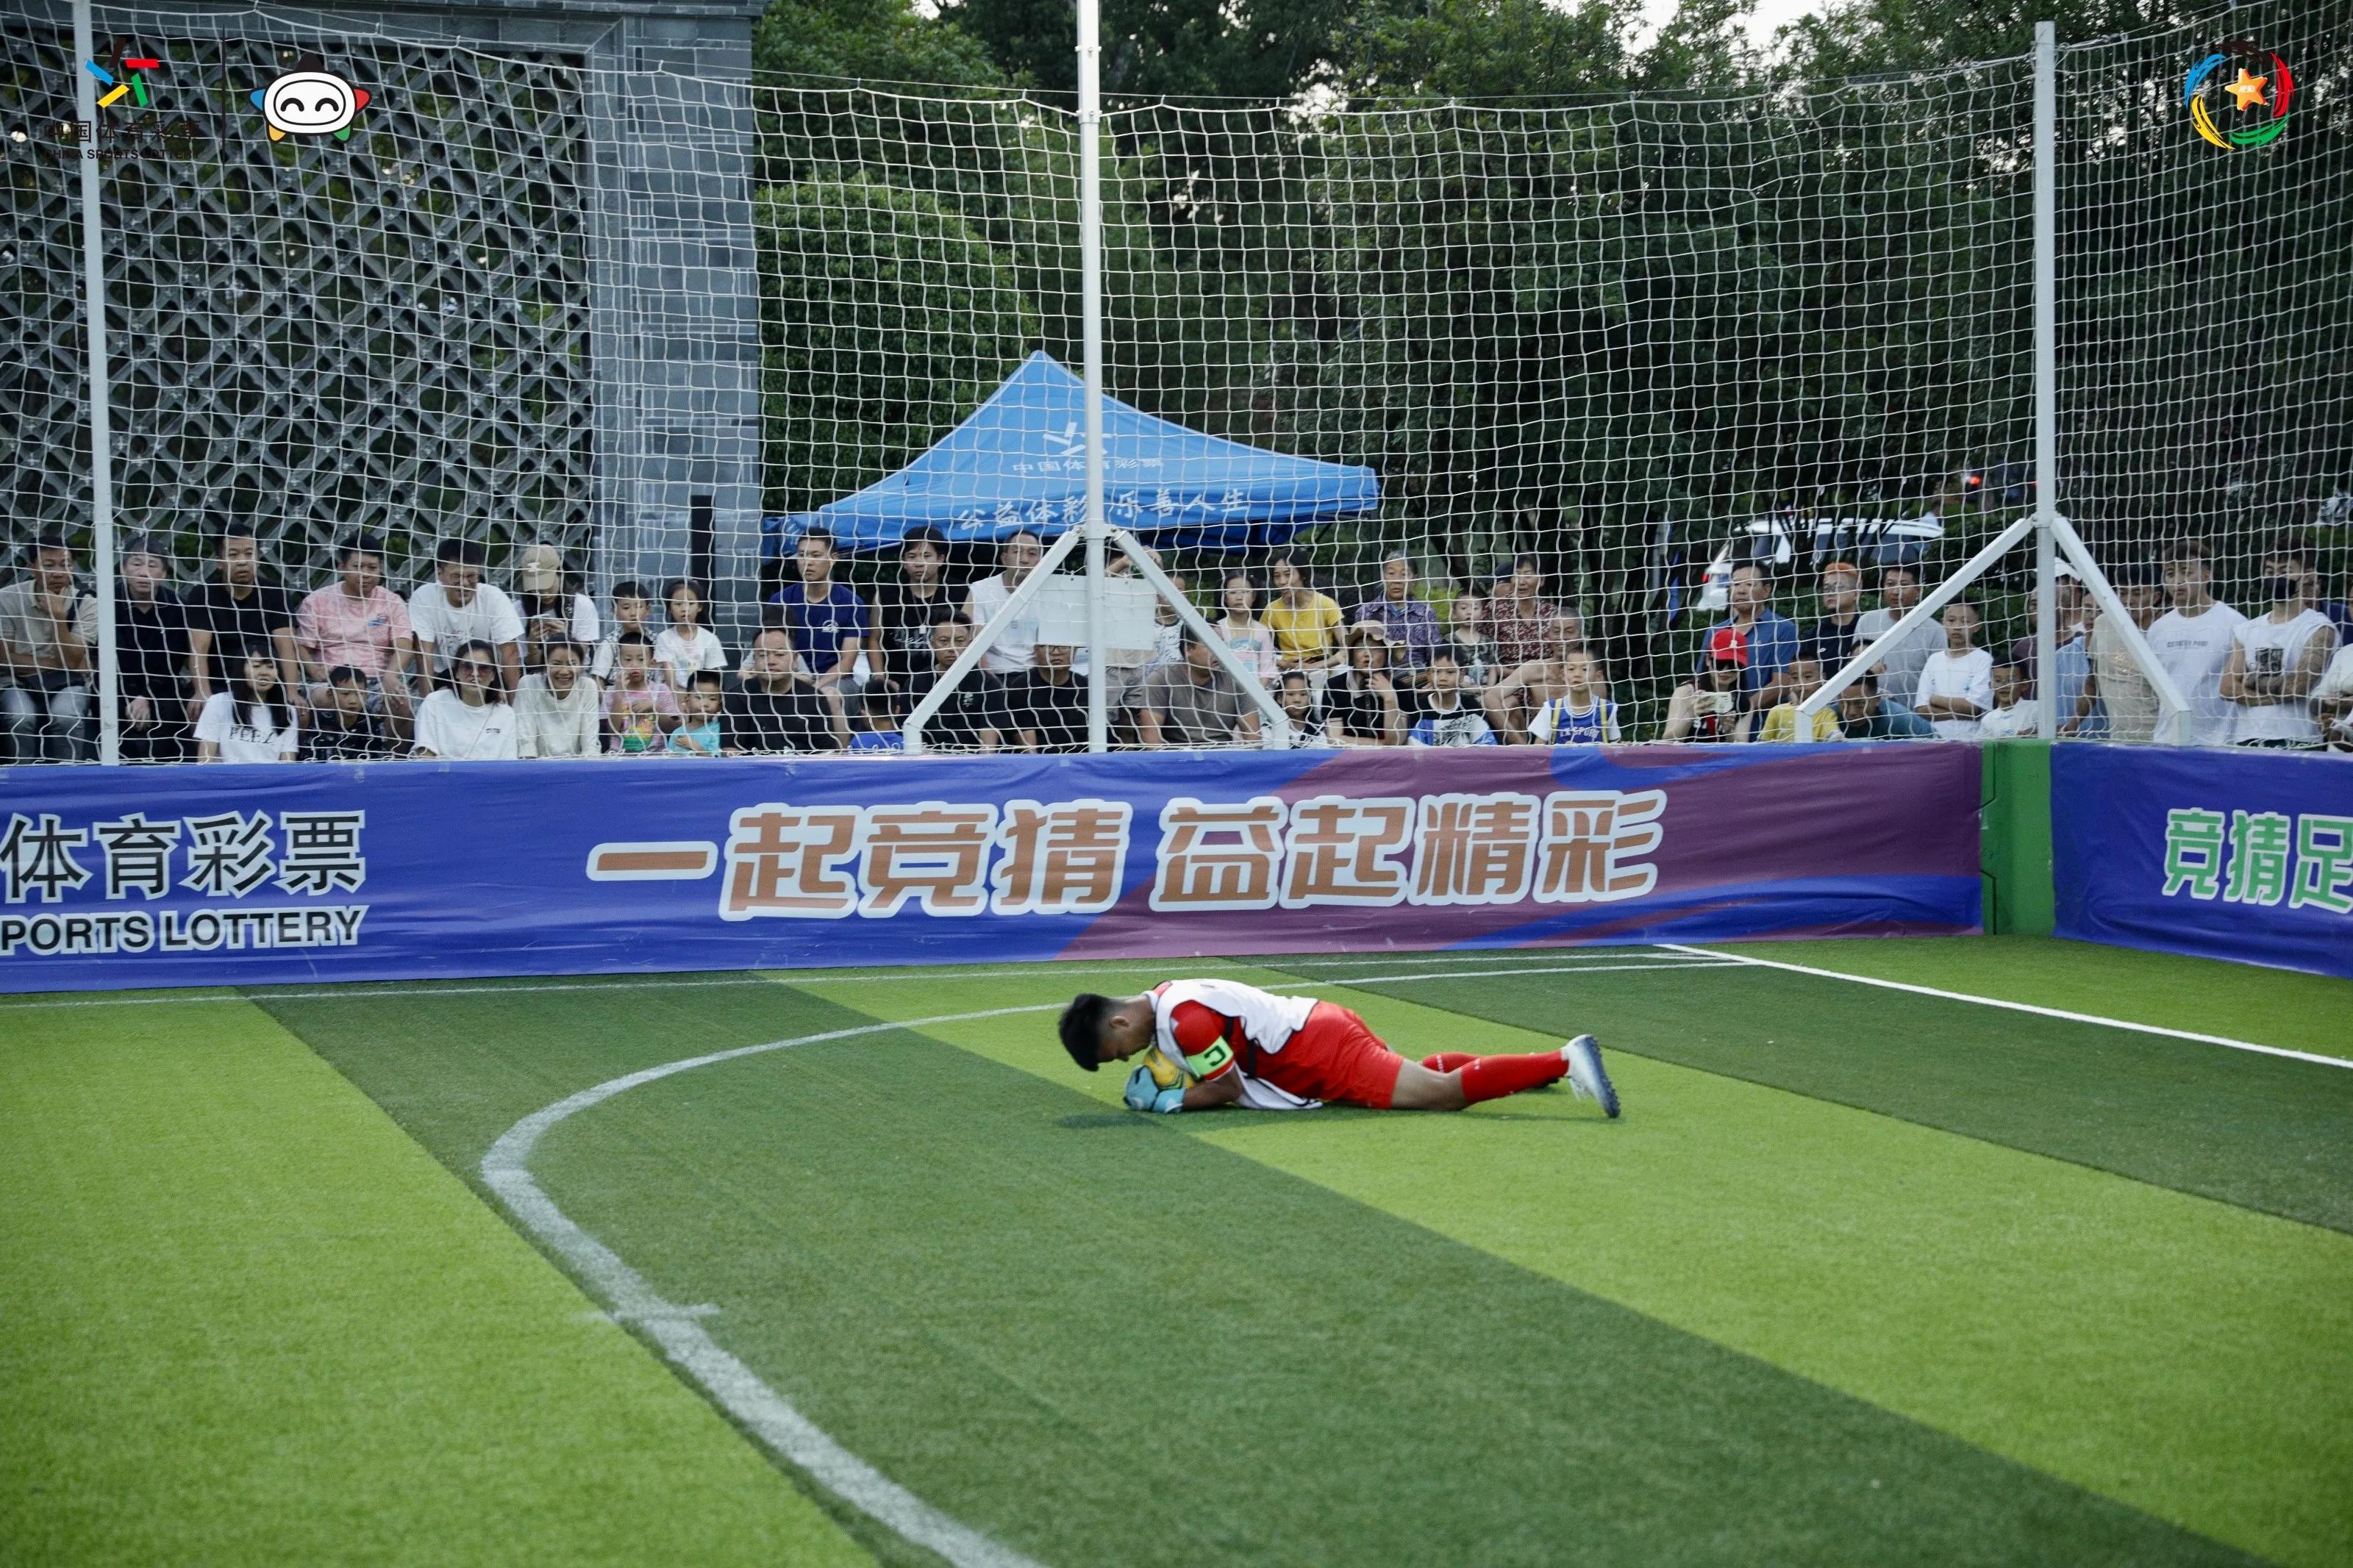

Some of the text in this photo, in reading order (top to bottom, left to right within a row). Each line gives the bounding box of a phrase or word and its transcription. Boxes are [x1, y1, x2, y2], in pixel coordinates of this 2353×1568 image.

[1116, 487, 1250, 518] 乐善人生
[0, 810, 365, 903] 体育彩票
[585, 790, 1667, 923] 一起竞猜 益起精彩
[2162, 806, 2353, 914] 竞猜足
[160, 905, 369, 951] LOTTERY
